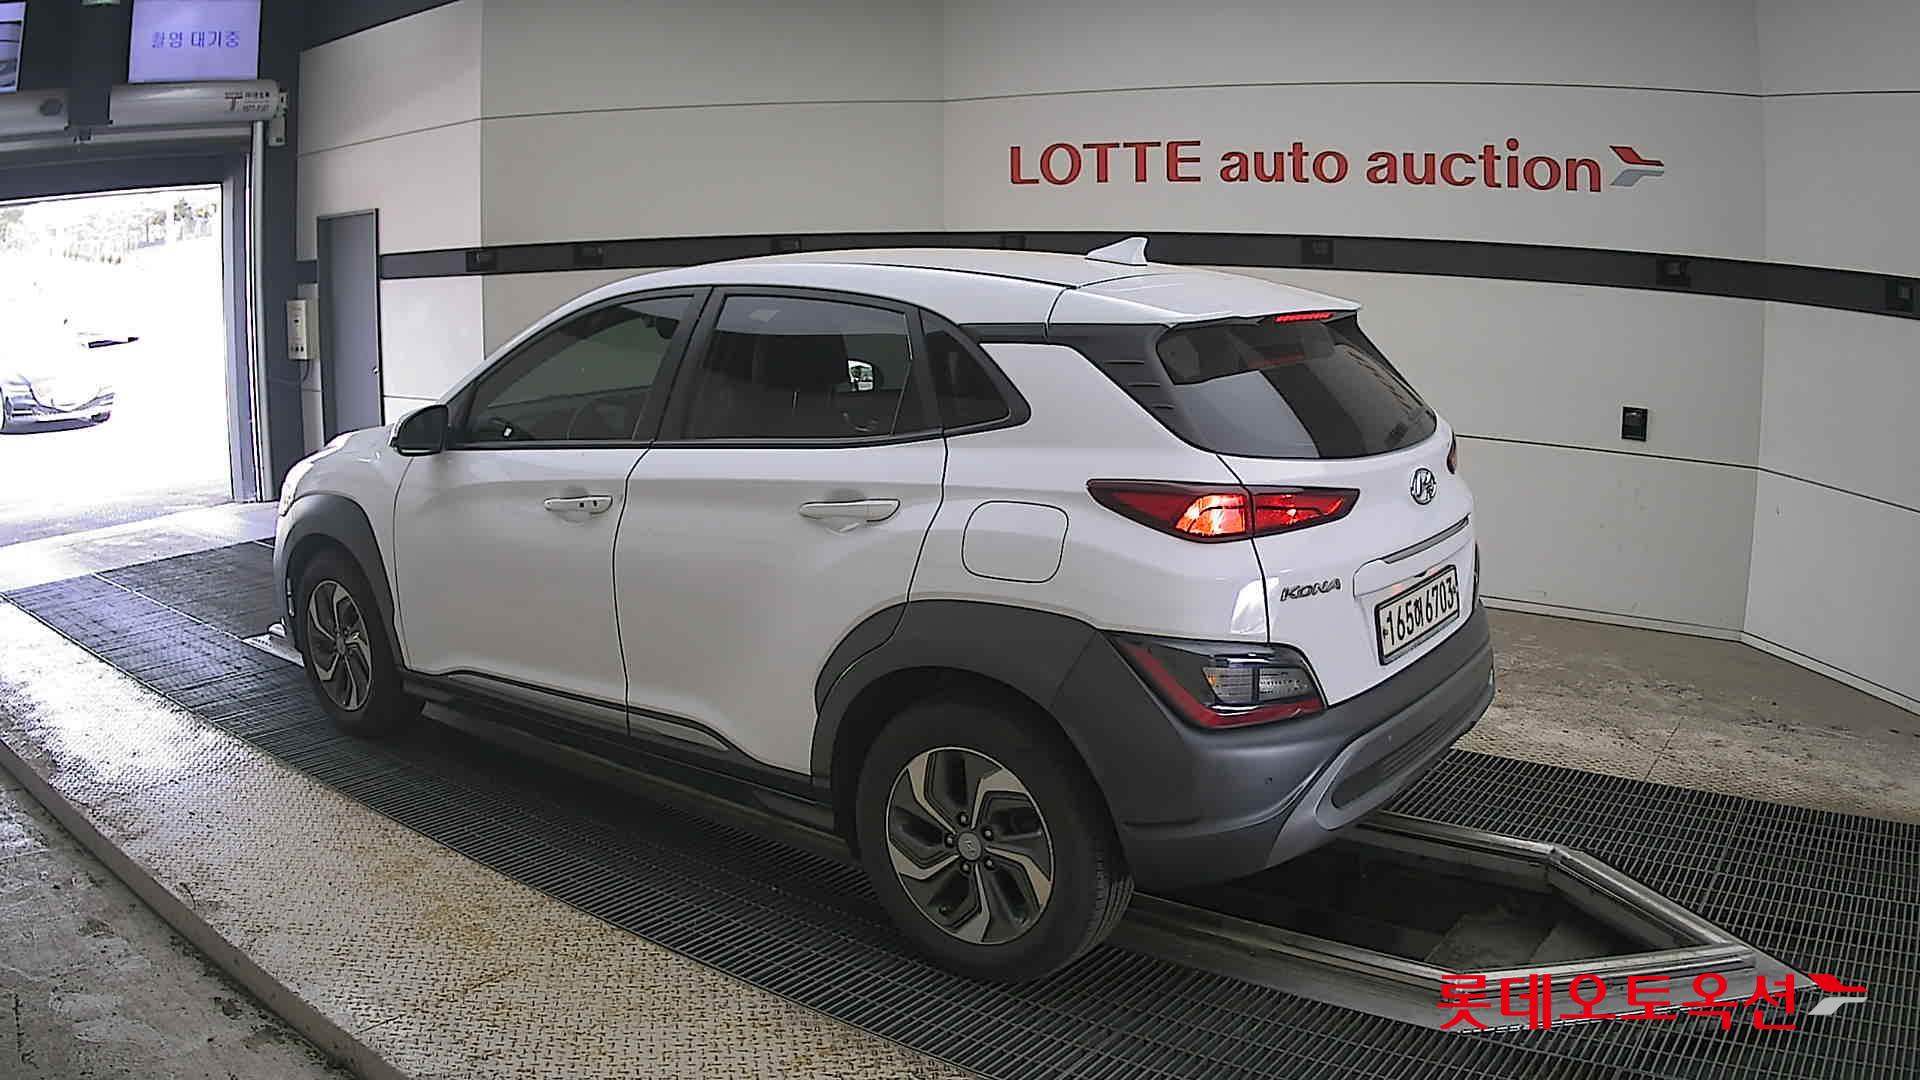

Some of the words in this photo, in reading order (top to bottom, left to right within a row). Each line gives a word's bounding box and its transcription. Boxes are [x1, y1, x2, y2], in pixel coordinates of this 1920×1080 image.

[191, 31, 240, 48] 대기중
[1009, 140, 1201, 185] LOTTE
[1219, 142, 1349, 184] auto
[1365, 137, 1601, 193] auction
[1280, 578, 1341, 602] KONA
